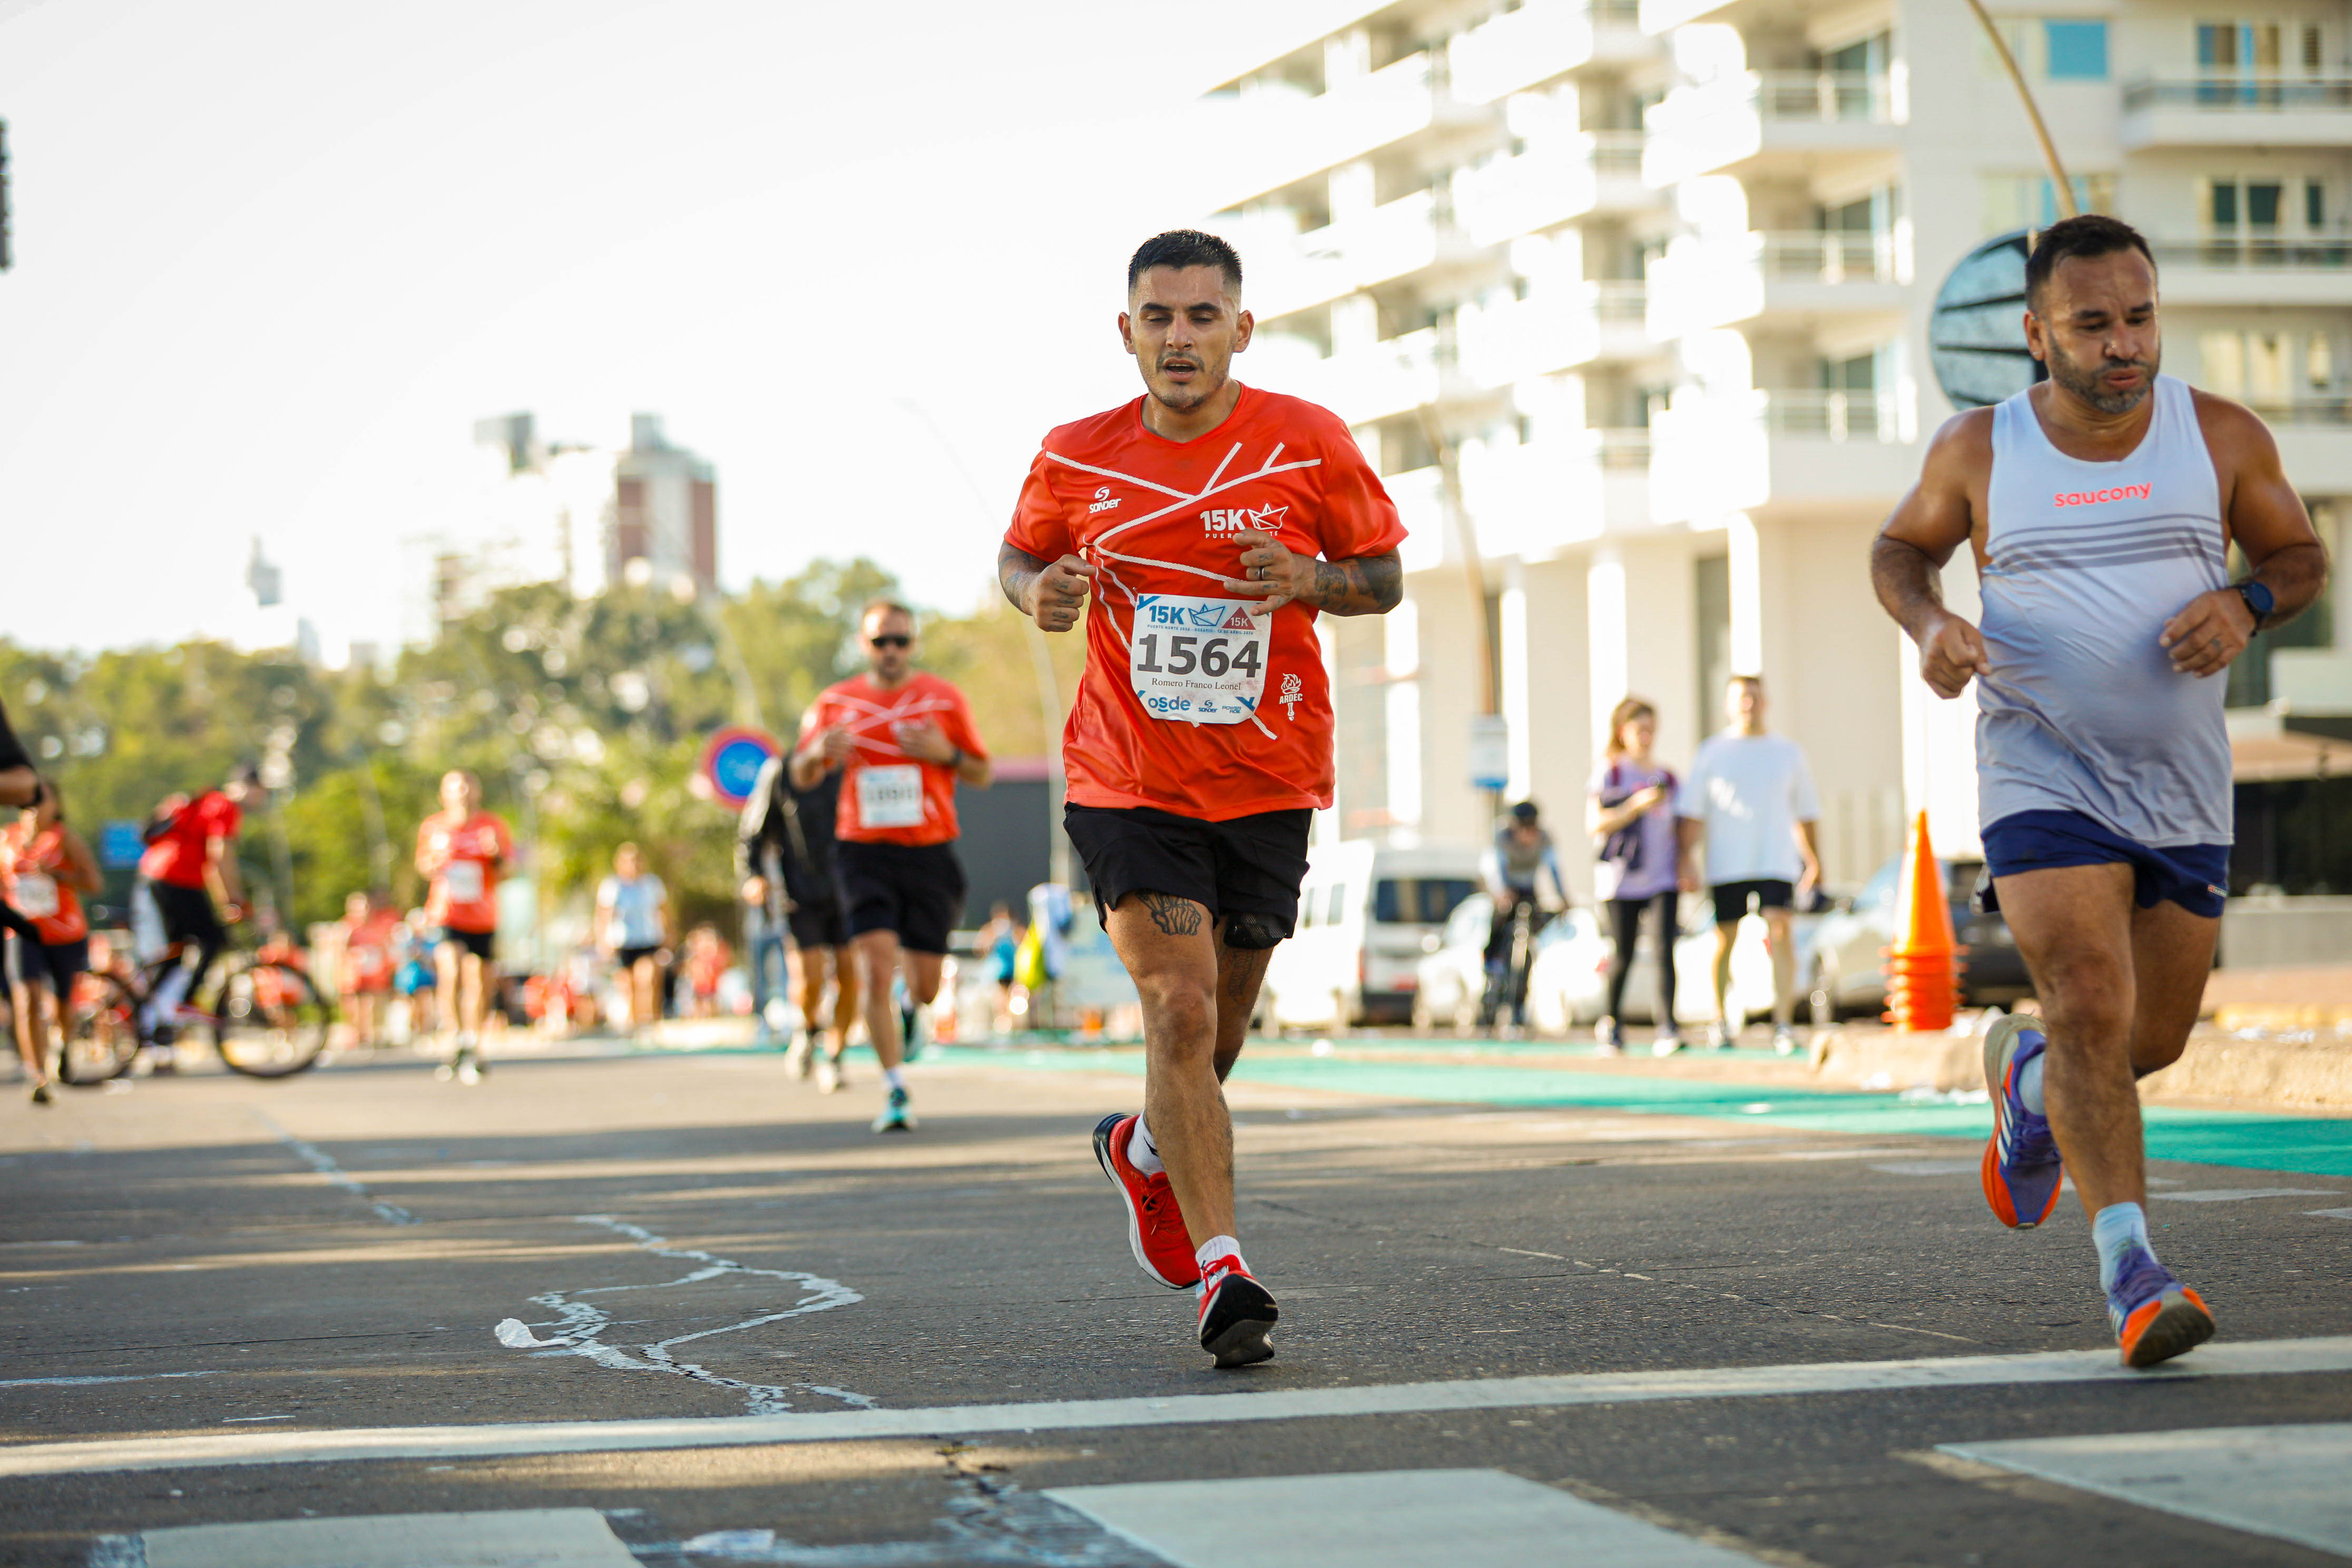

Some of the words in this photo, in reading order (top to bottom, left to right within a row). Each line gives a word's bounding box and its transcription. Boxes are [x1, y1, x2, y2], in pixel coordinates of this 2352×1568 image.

[2054, 482, 2152, 507] saucony
[1200, 509, 1246, 531] 15K
[1149, 605, 1185, 624] 15K
[1230, 617, 1248, 626] 15K
[1137, 634, 1261, 678] 1564
[1152, 678, 1183, 687] Romero
[1185, 680, 1212, 689] Franco
[1215, 682, 1241, 690] Leonel
[1148, 695, 1191, 712] osde
[1279, 693, 1302, 704] ARDEC
